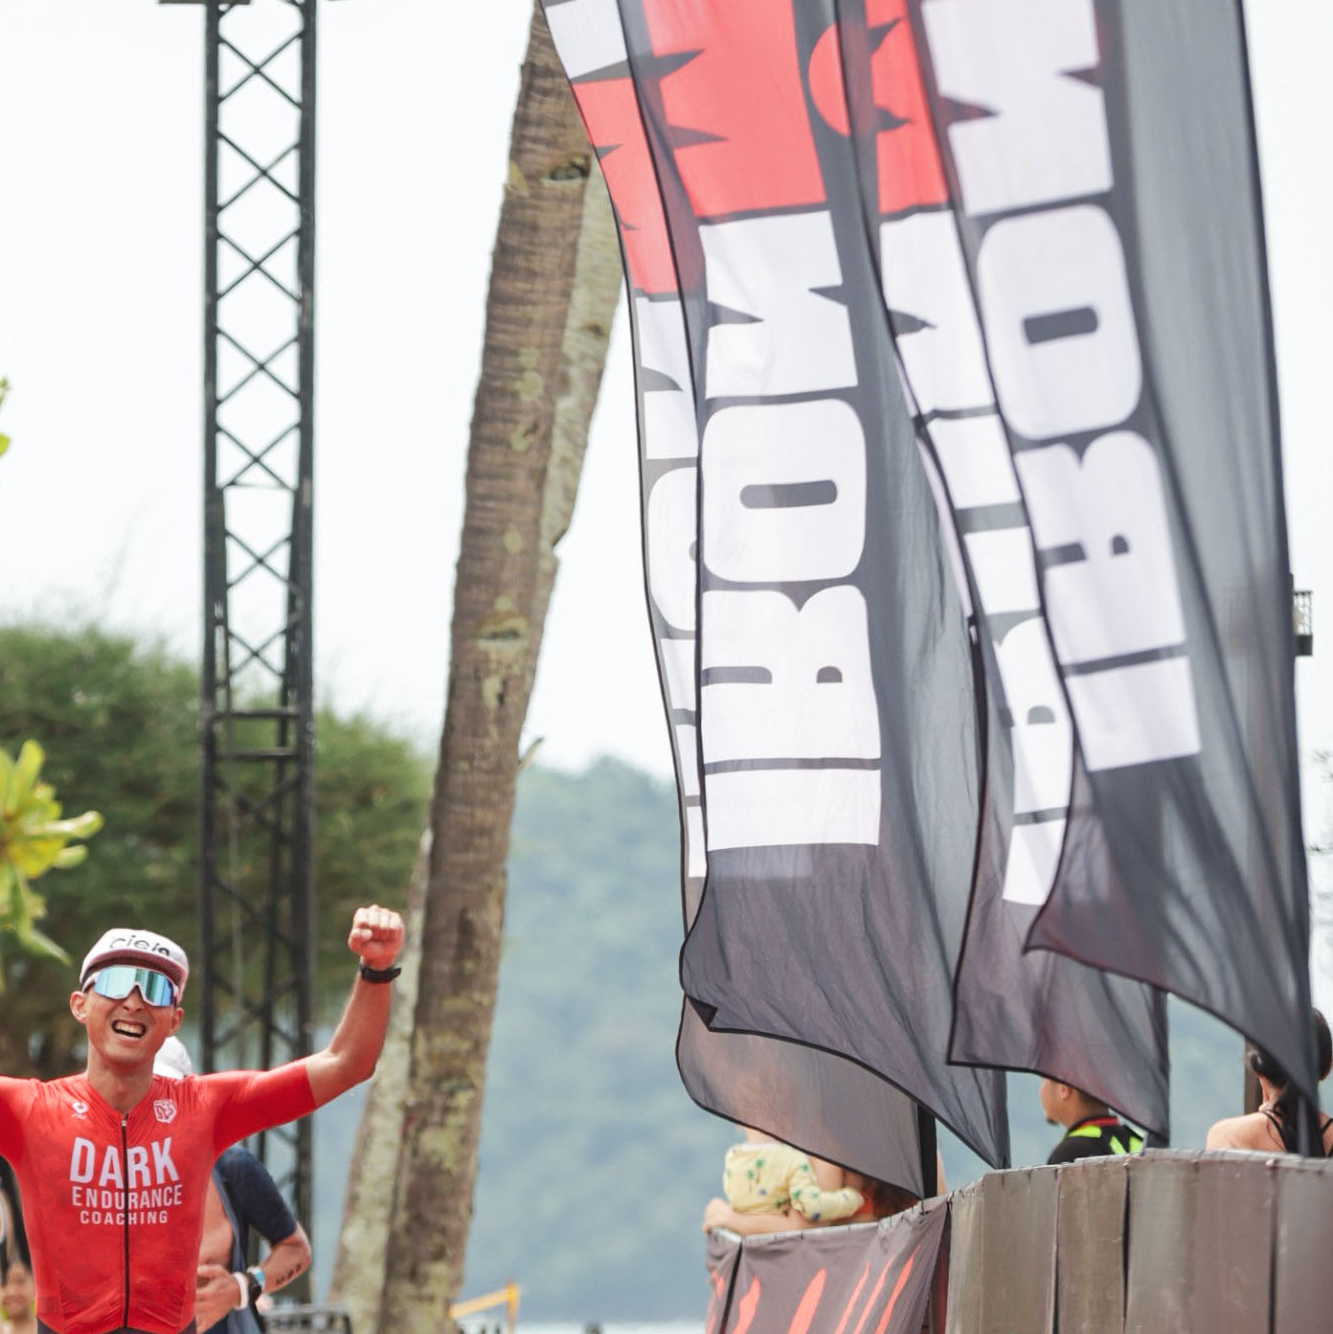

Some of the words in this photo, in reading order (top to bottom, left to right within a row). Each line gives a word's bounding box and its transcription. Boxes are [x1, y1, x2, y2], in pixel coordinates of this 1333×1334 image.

[69, 1136, 180, 1190] DARK
[72, 1184, 183, 1210] ENDURANCE
[80, 1210, 169, 1225] COACHING
